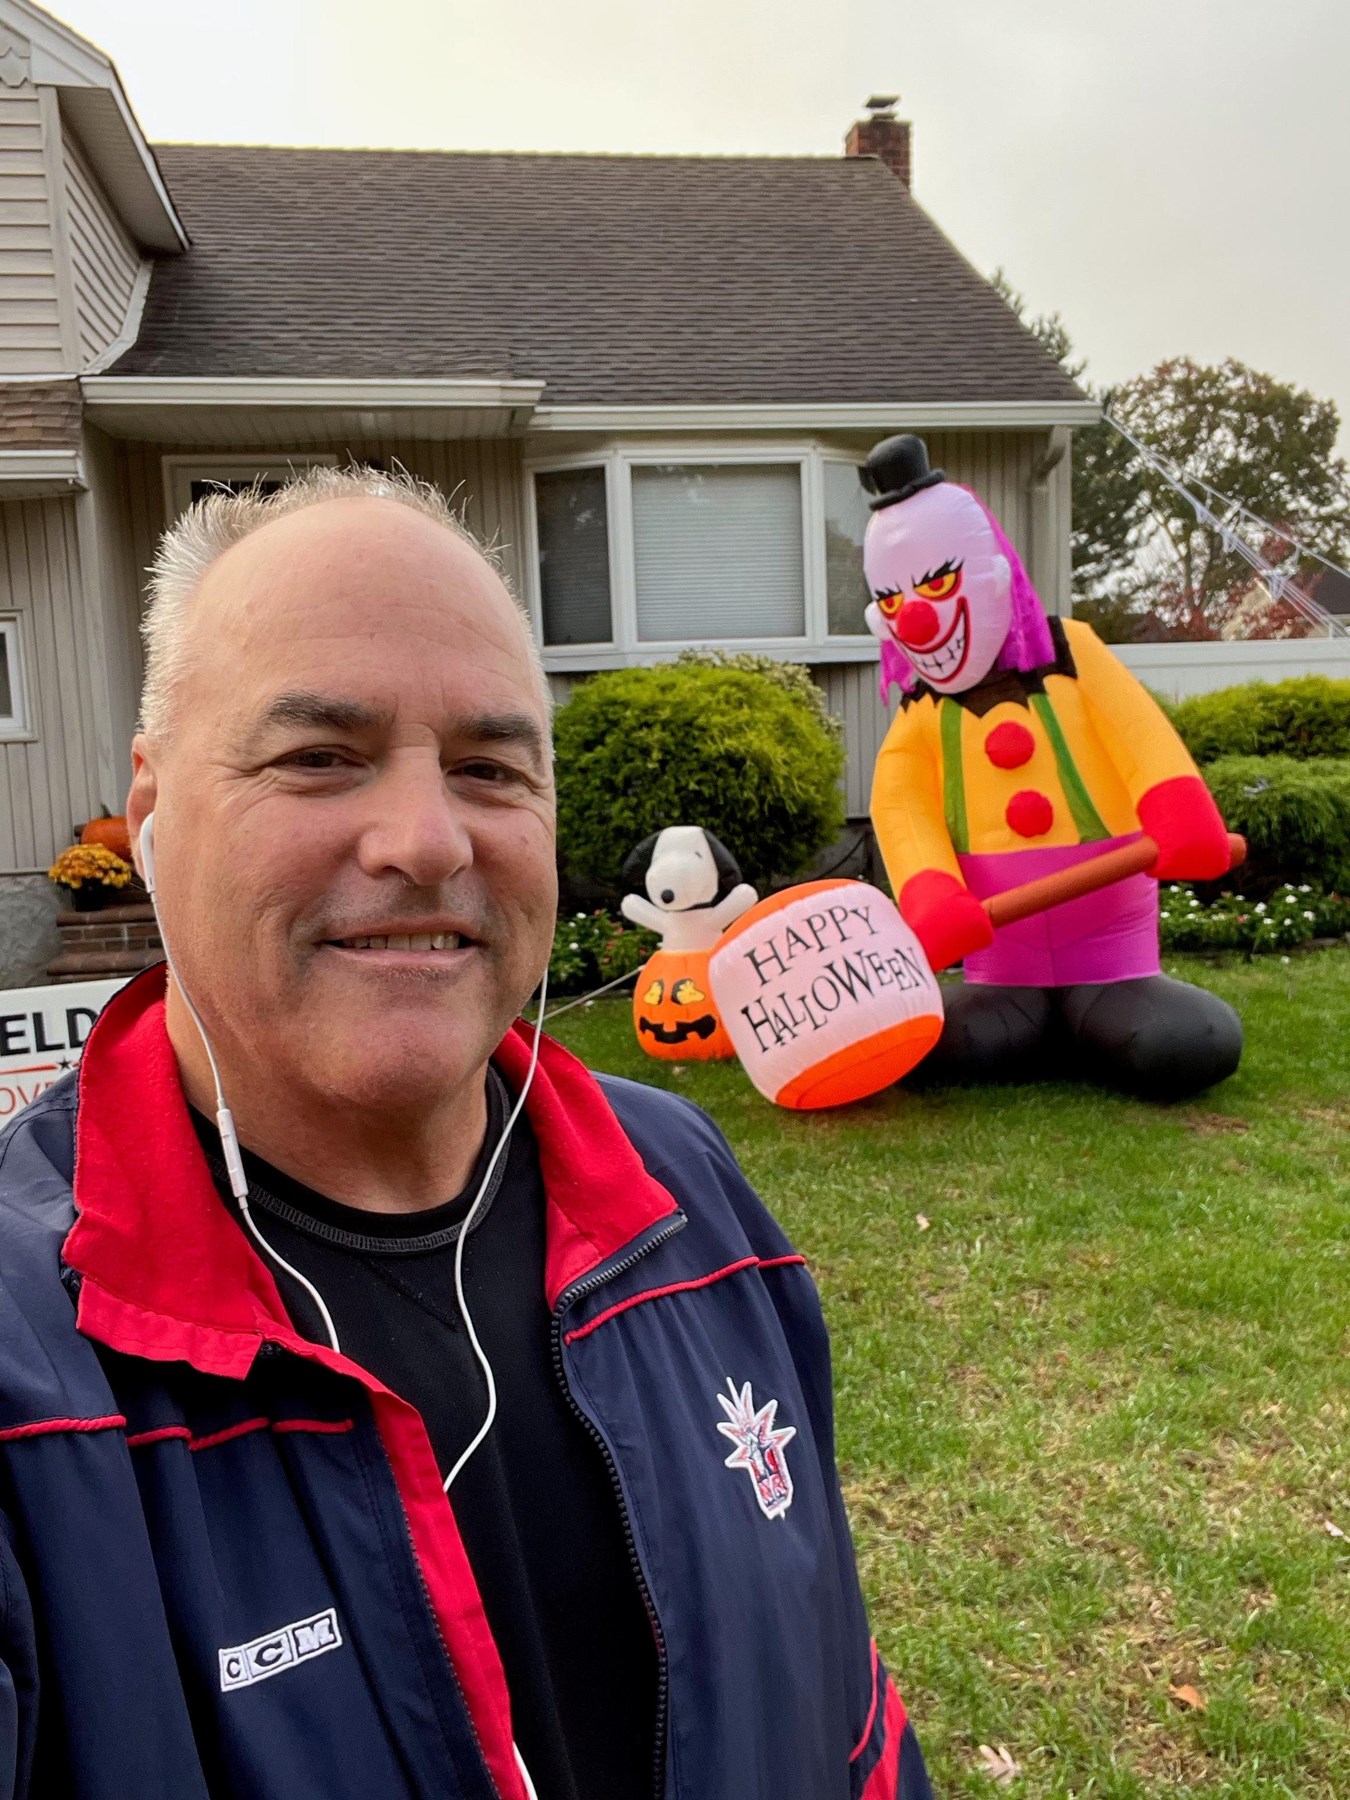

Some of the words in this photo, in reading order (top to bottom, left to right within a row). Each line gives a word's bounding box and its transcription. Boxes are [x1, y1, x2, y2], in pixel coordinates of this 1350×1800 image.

[744, 905, 879, 987] HAPPY
[0, 1007, 99, 1056] ELD
[740, 947, 929, 1053] HALLOWEEN
[0, 1081, 54, 1115] OV
[226, 1616, 335, 1679] CCM
